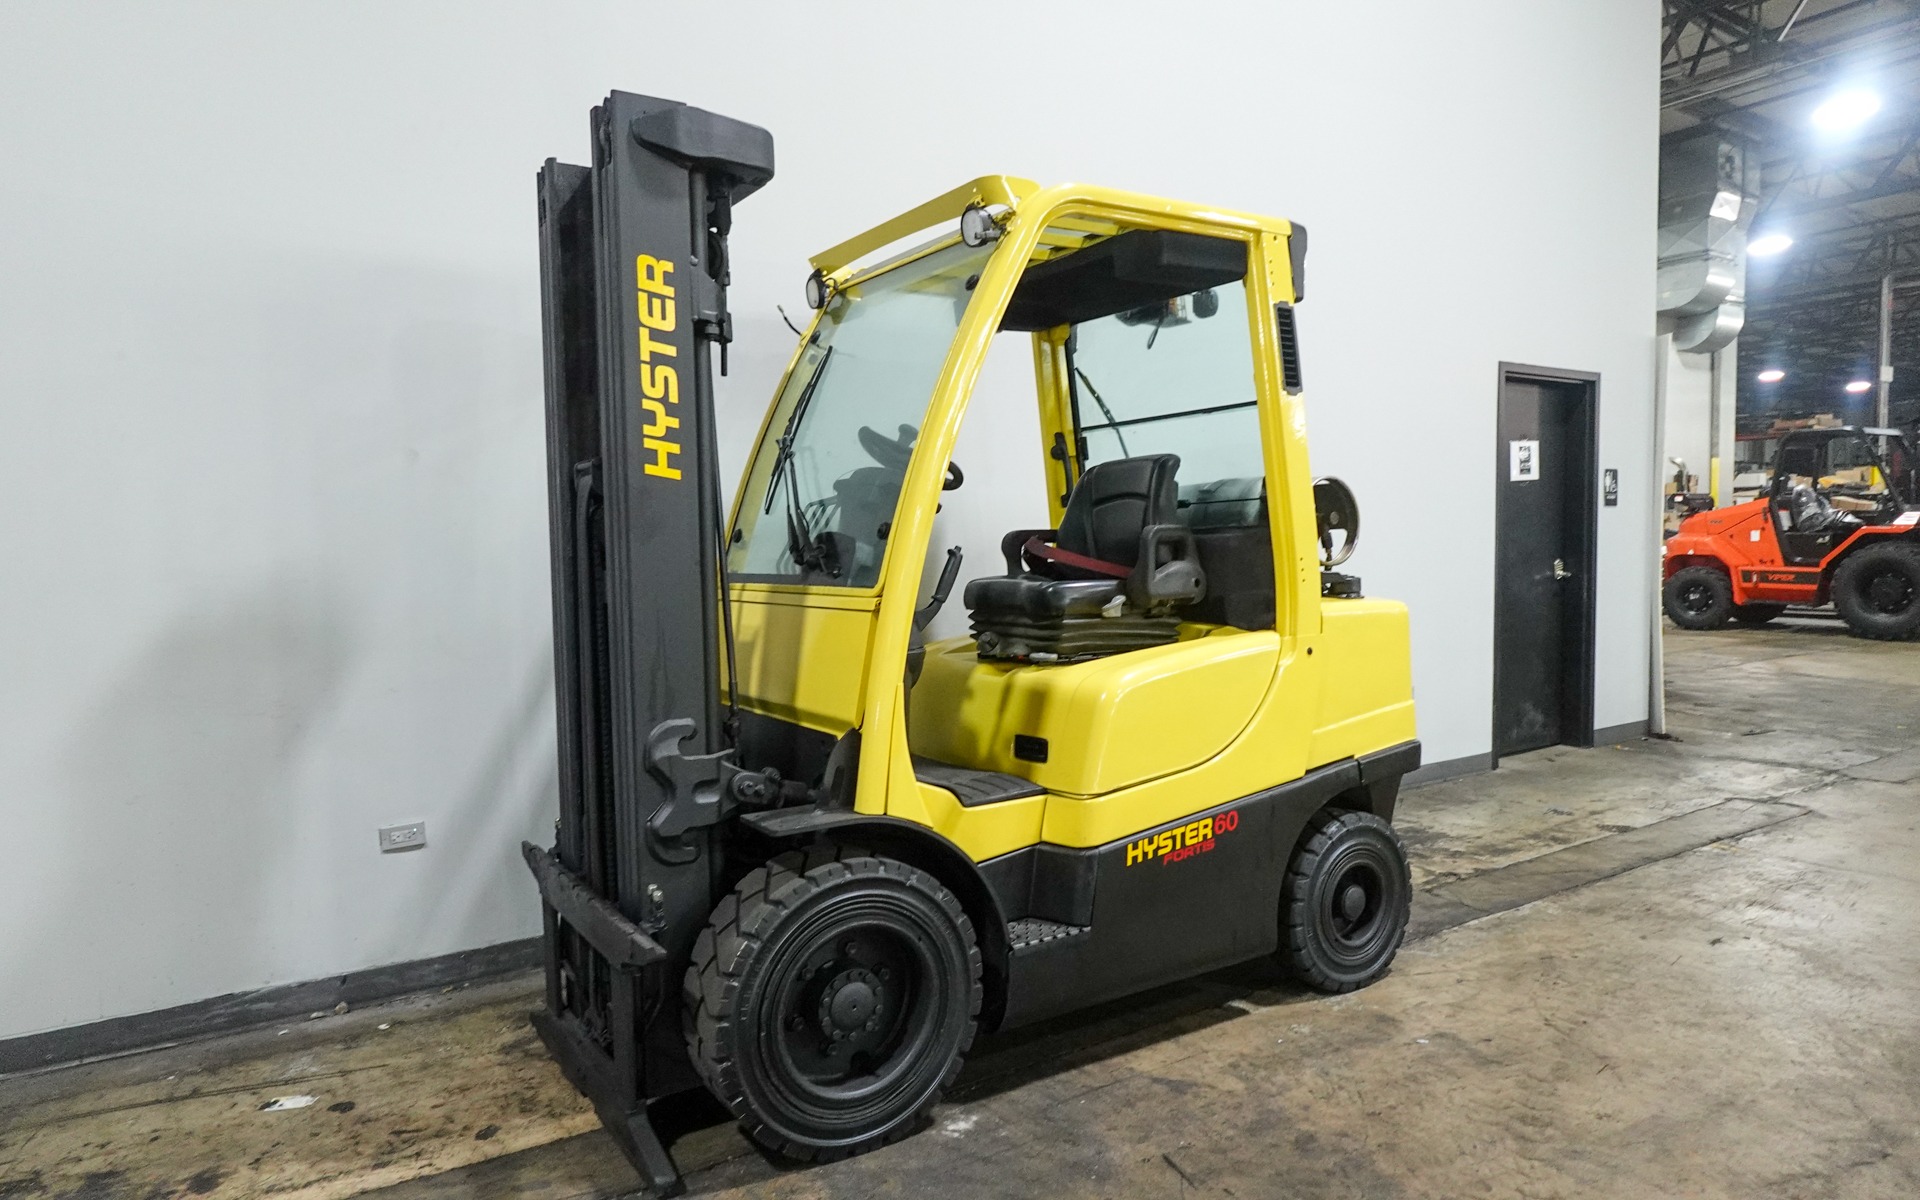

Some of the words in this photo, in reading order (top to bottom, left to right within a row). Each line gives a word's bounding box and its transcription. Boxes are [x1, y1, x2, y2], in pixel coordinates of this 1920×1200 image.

[636, 254, 682, 481] HYSTER
[1126, 818, 1213, 866] HYSTER
[1214, 810, 1238, 834] 60
[1163, 838, 1216, 866] FORTIS
